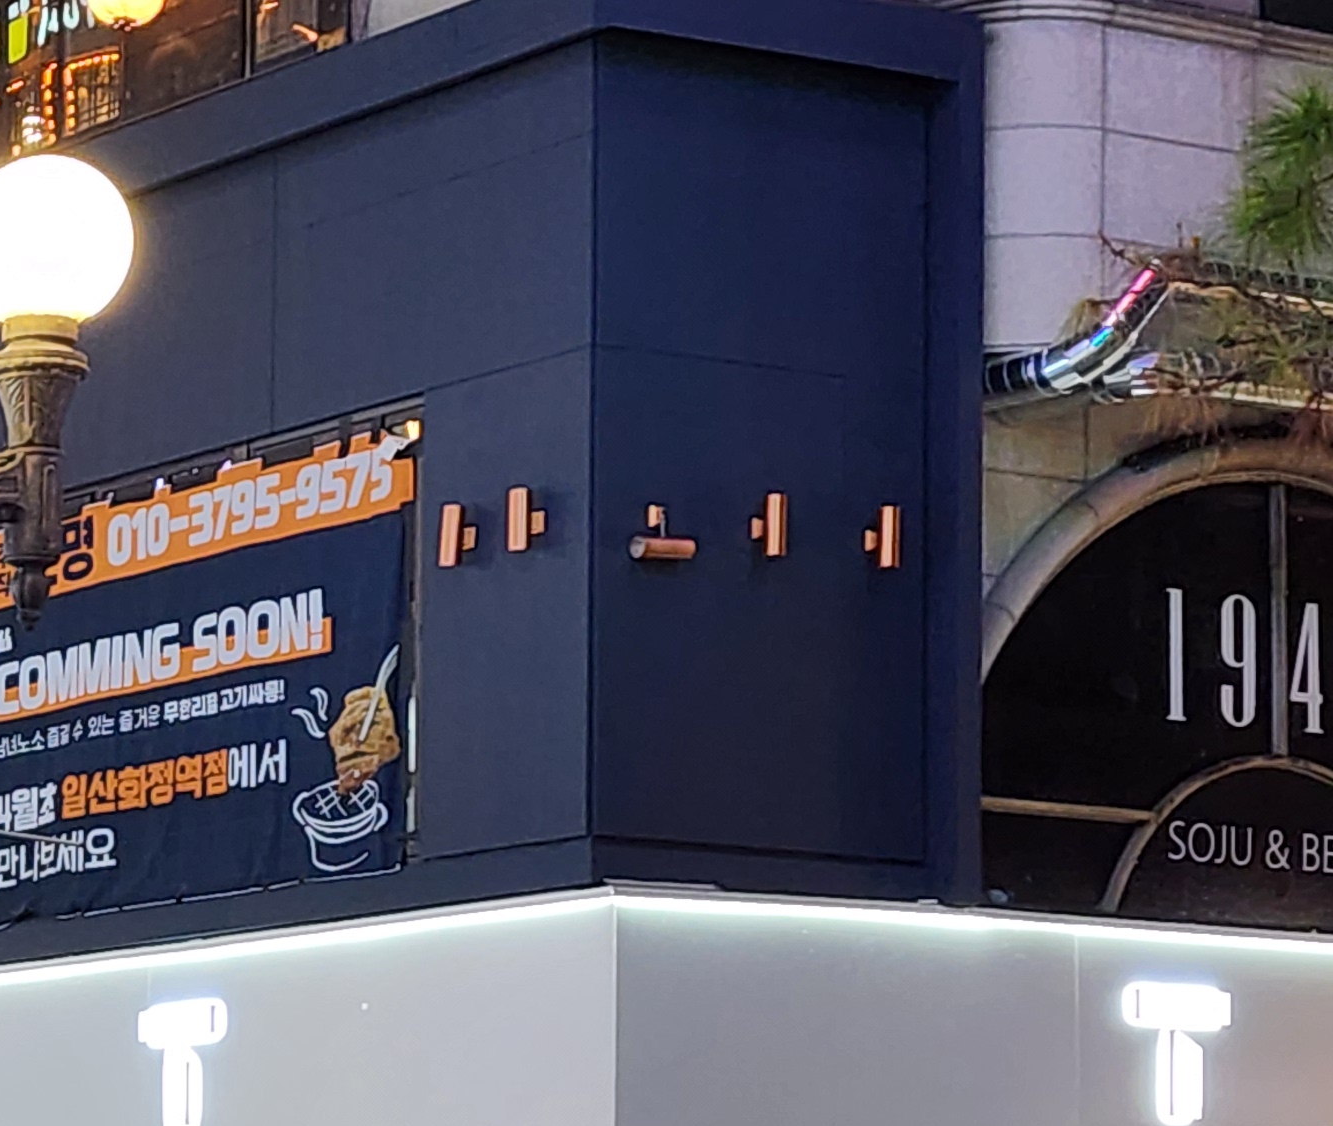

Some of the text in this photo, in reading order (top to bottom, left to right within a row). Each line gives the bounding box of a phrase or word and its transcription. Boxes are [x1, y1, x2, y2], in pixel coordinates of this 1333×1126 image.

[105, 447, 395, 566] 010-3795-9575
[191, 588, 326, 670] SOON!
[87, 715, 115, 738] 있는
[162, 692, 220, 723] 무한리필
[61, 739, 286, 820] 일산화정역점에서
[1167, 820, 1253, 866] SOJU
[1265, 829, 1291, 870] &
